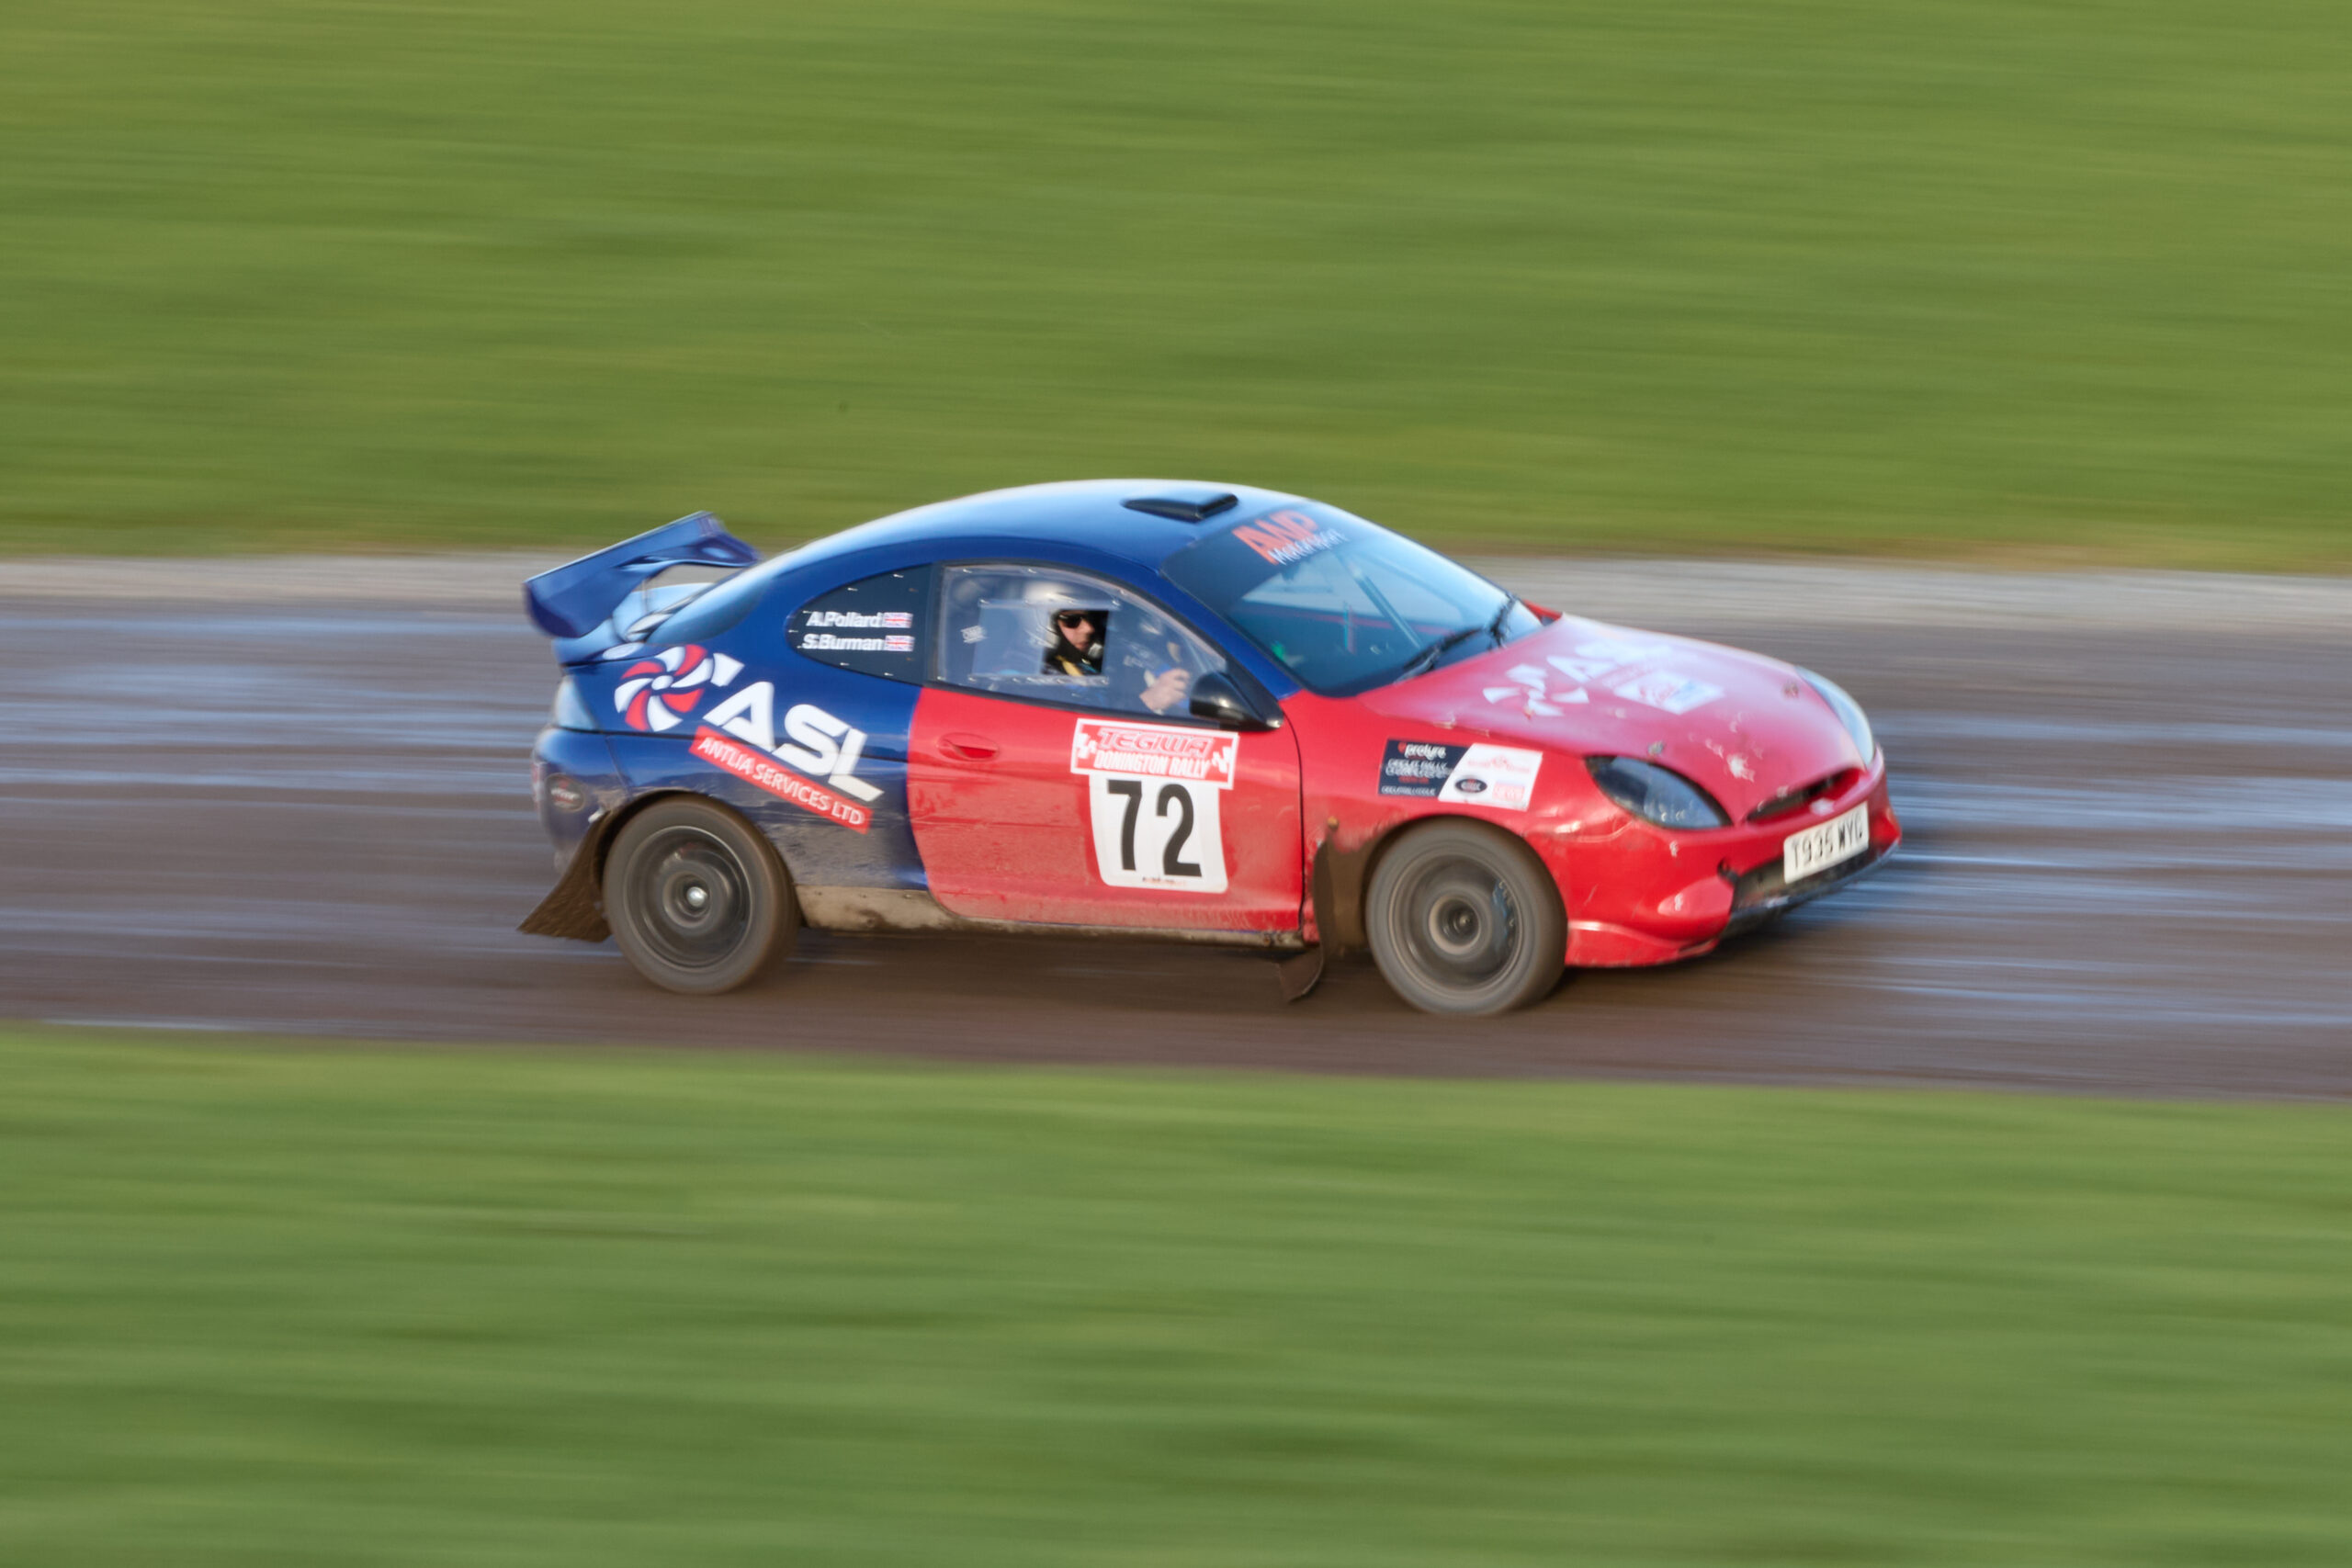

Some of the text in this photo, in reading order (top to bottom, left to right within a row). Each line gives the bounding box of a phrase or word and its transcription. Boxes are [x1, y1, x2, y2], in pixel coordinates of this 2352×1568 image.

[802, 634, 886, 650] S.Burman
[806, 611, 883, 627] A.Pollard
[703, 682, 884, 802] ASL
[1095, 750, 1212, 779] DONINGTON RALLY
[697, 736, 865, 827] ANTLIA SERVICES LTD
[1107, 779, 1202, 877] 72
